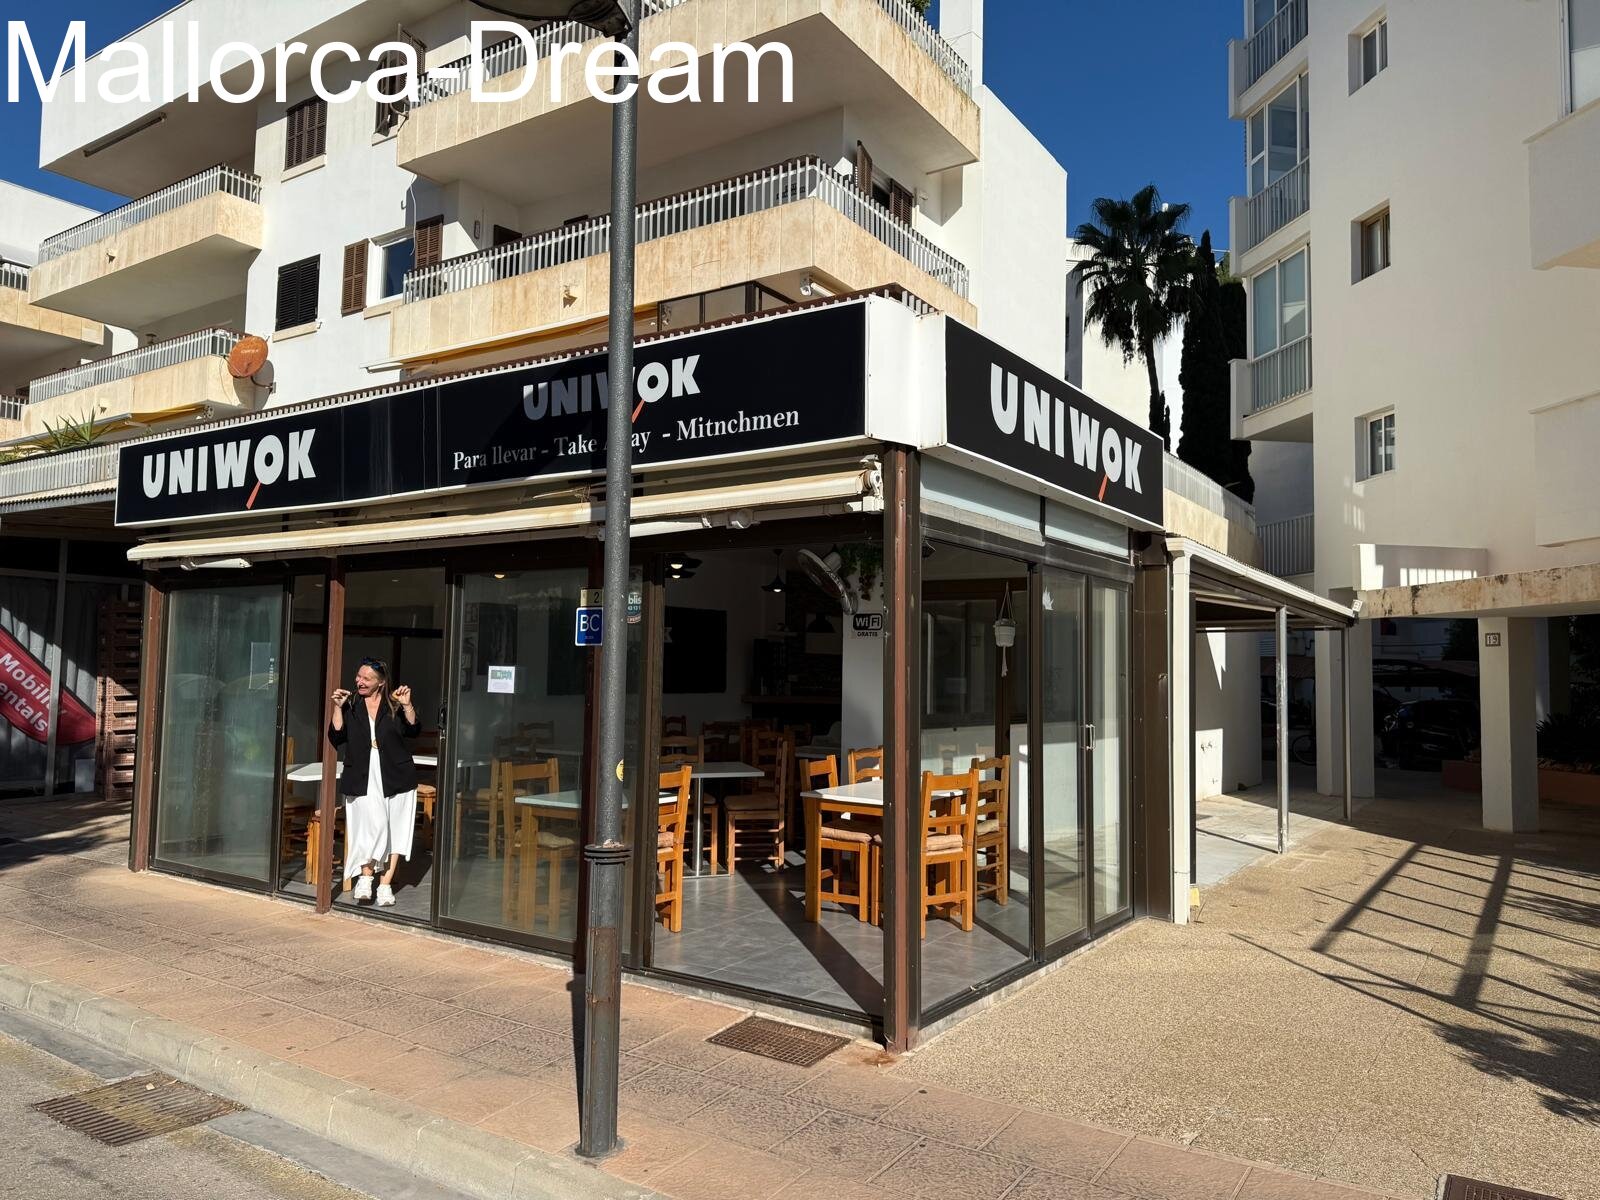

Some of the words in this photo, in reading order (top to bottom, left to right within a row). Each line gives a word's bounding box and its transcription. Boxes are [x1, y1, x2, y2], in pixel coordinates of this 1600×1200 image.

[453, 451, 487, 470] Para
[492, 445, 537, 465] llevar
[554, 434, 598, 456] Take
[603, 431, 651, 454] ay
[676, 410, 800, 441] Mitnchmen
[991, 362, 1142, 494] UNIWOK
[142, 428, 316, 499] UNIWOK
[580, 614, 600, 632] BC
[1487, 635, 1498, 644] 19
[0, 653, 68, 715] Mobili
